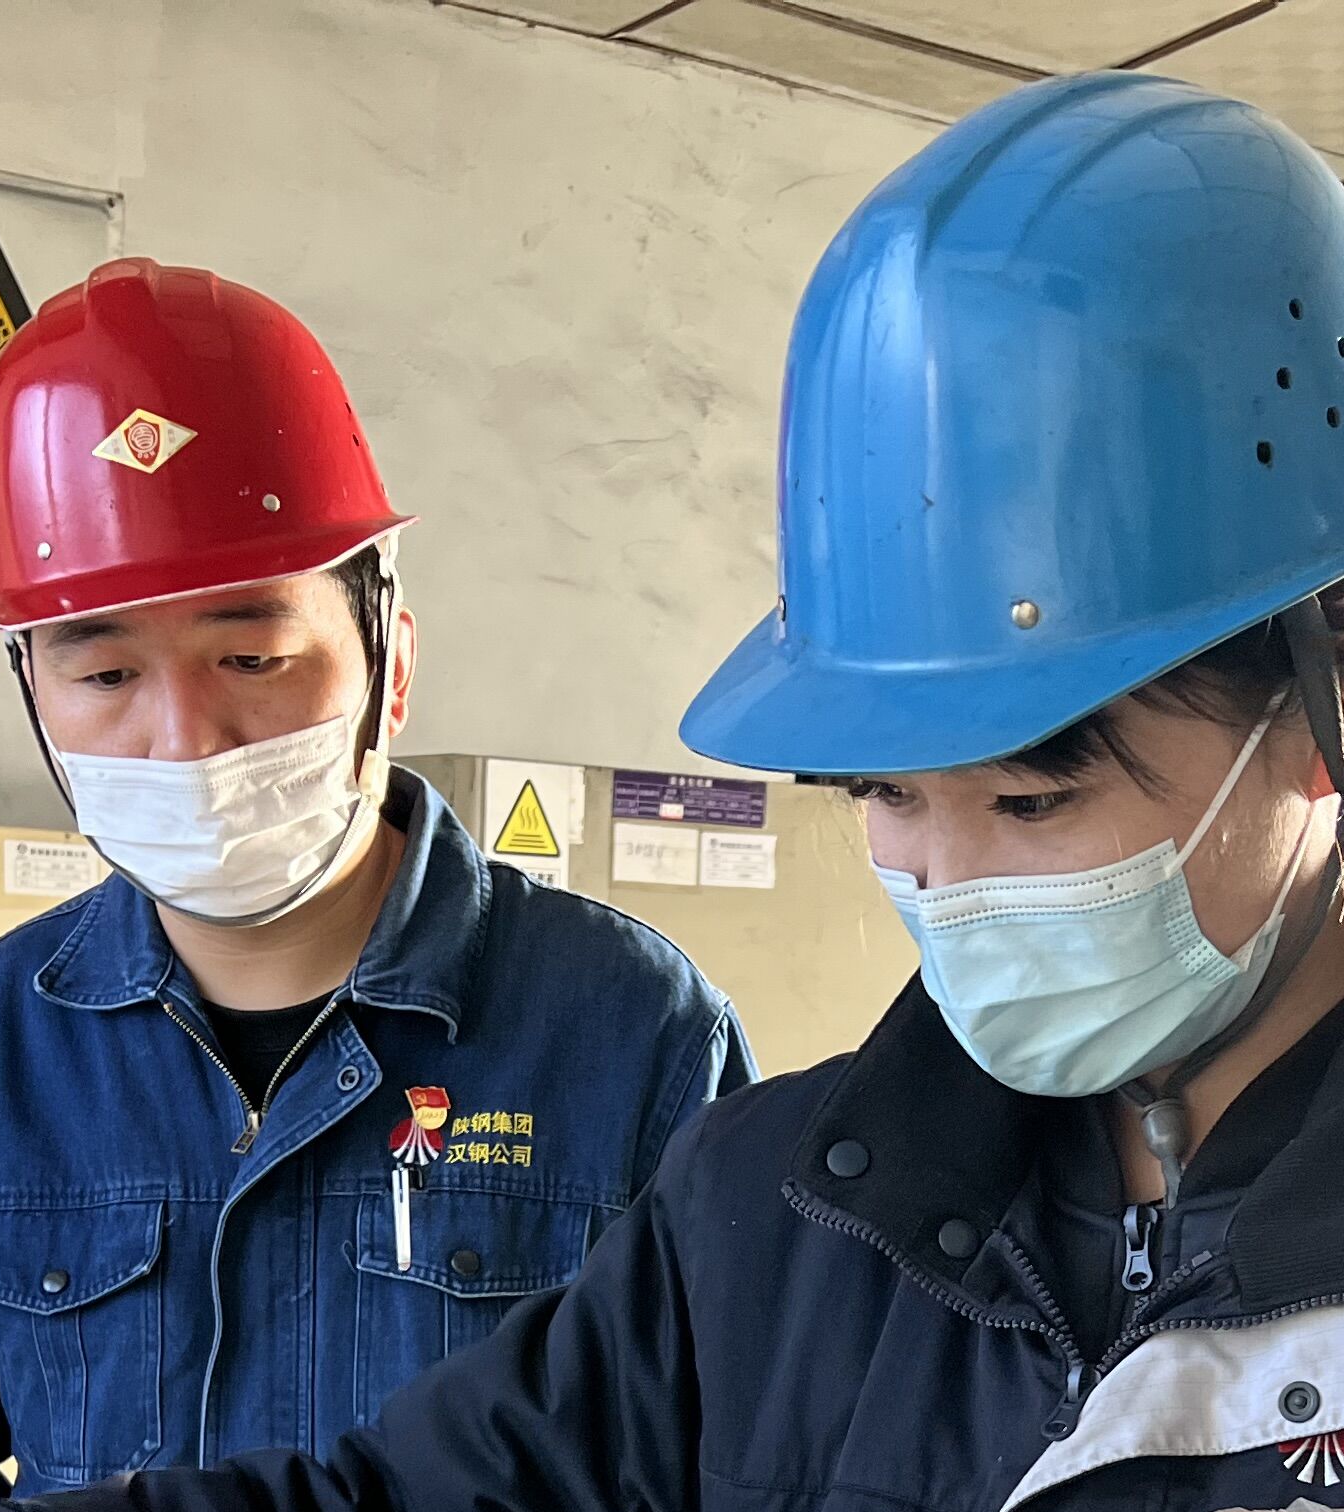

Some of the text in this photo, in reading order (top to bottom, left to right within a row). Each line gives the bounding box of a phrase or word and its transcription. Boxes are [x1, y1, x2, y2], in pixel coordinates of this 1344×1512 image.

[451, 1111, 533, 1138] 陕钢集团
[445, 1142, 532, 1168] 汉钢公司
